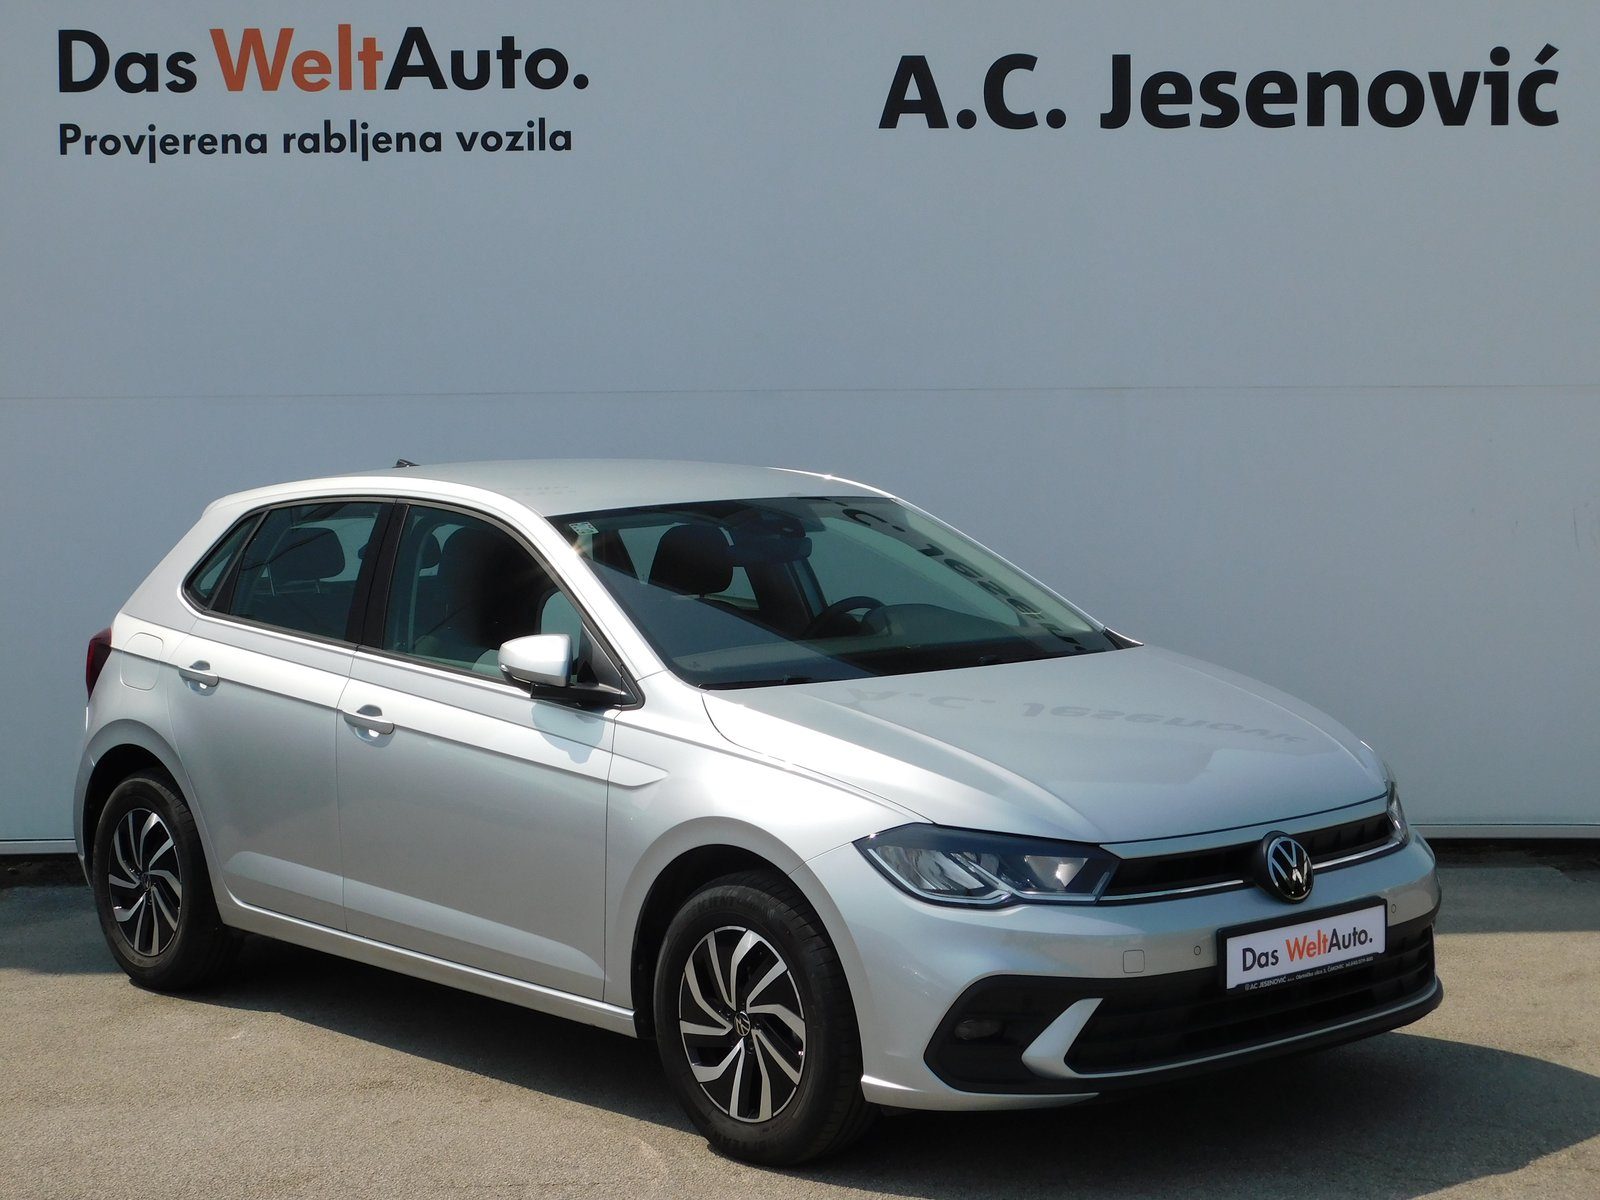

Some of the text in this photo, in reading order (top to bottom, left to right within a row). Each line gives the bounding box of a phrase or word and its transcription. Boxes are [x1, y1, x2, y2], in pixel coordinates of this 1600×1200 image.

[57, 23, 590, 94] Das WeltAuto.
[878, 42, 1560, 130] A.C. Jesenović
[59, 116, 572, 164] Provjerena rabljena vozila
[1242, 926, 1373, 972] Das WeltAuto.
